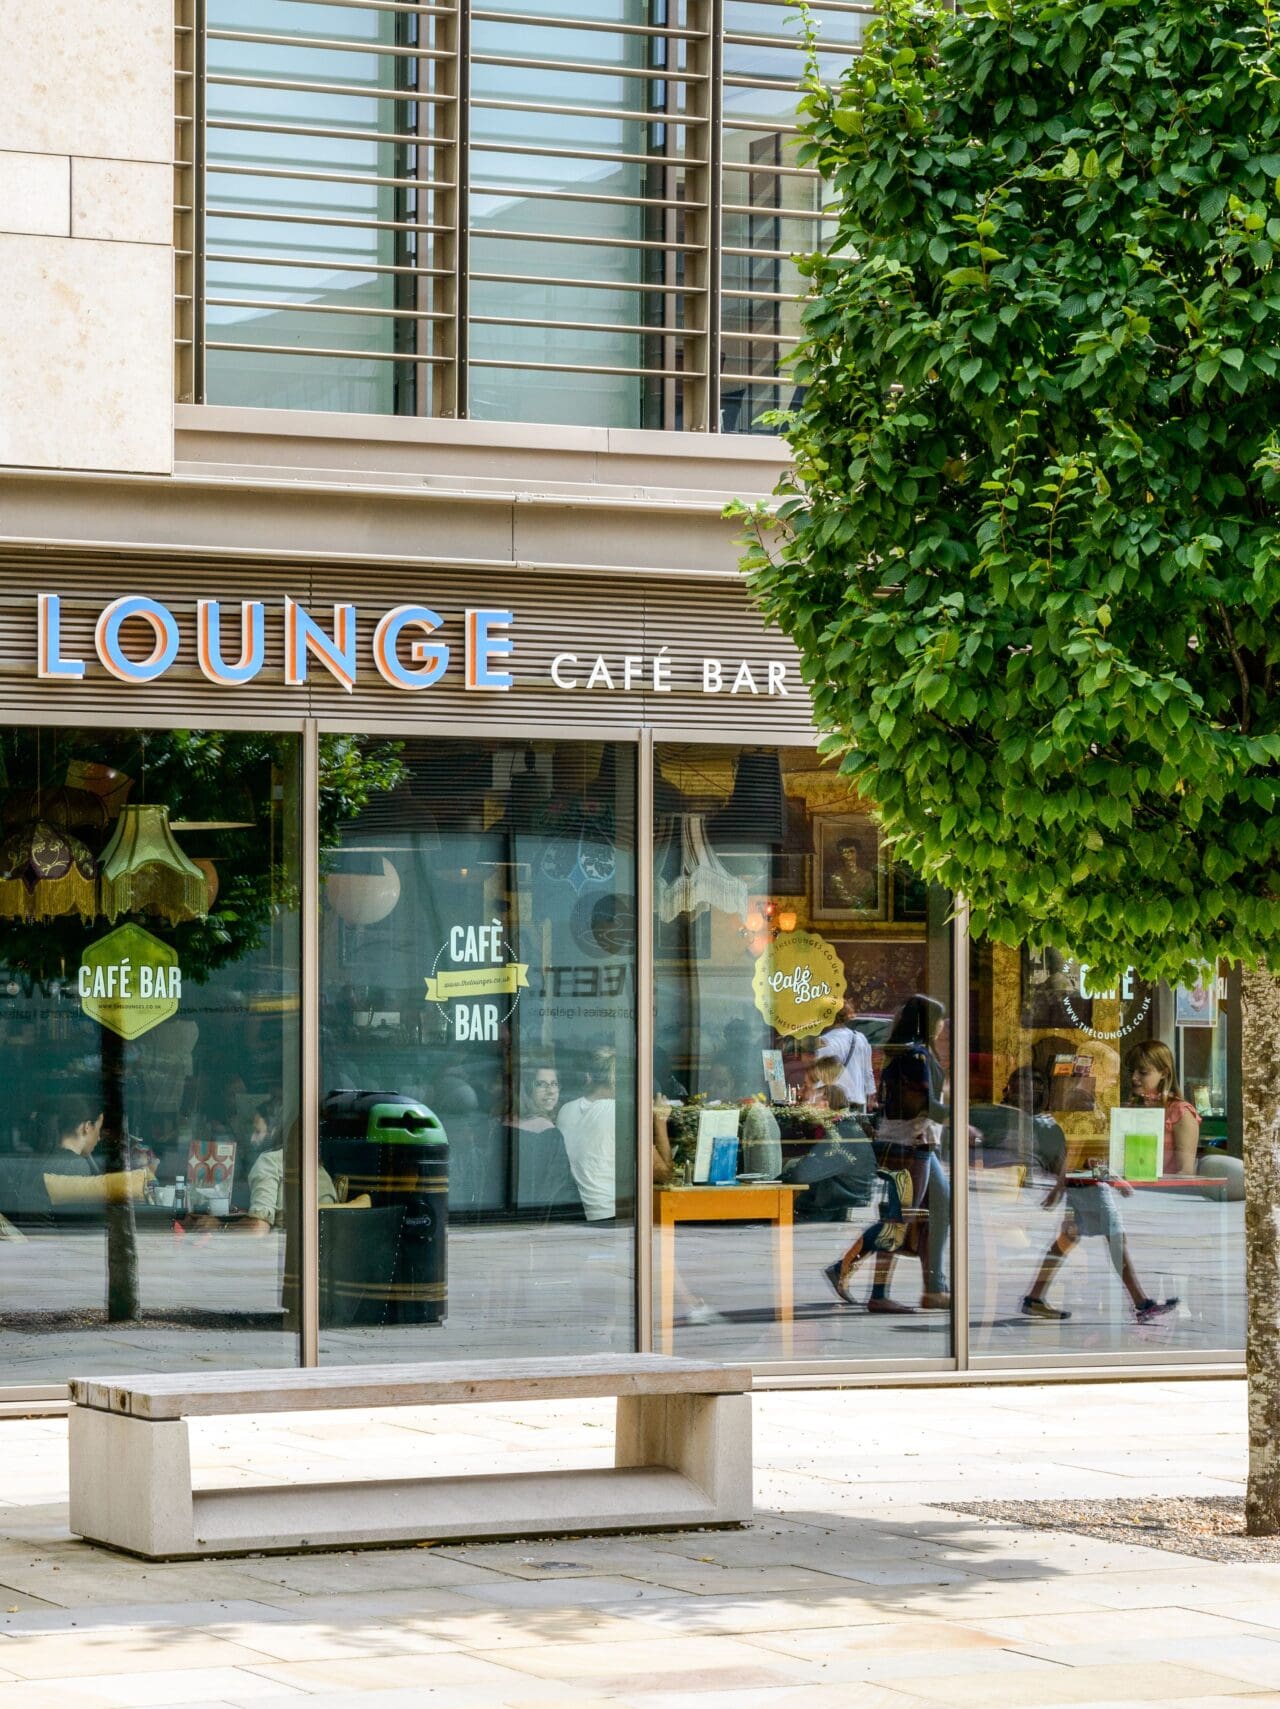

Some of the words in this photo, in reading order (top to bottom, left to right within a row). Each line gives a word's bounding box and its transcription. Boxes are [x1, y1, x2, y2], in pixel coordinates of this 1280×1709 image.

[37, 593, 514, 695] LOUNGE
[550, 646, 672, 692] CAFÉ
[703, 659, 789, 696] BAR
[78, 957, 132, 998] CAFÉ
[140, 966, 182, 998] BAR
[768, 965, 813, 994] Café
[795, 982, 831, 1004] Bar
[454, 1004, 499, 1041] BAR
[1063, 996, 1152, 1040] WWW.THELOUNGES.CO.UK
